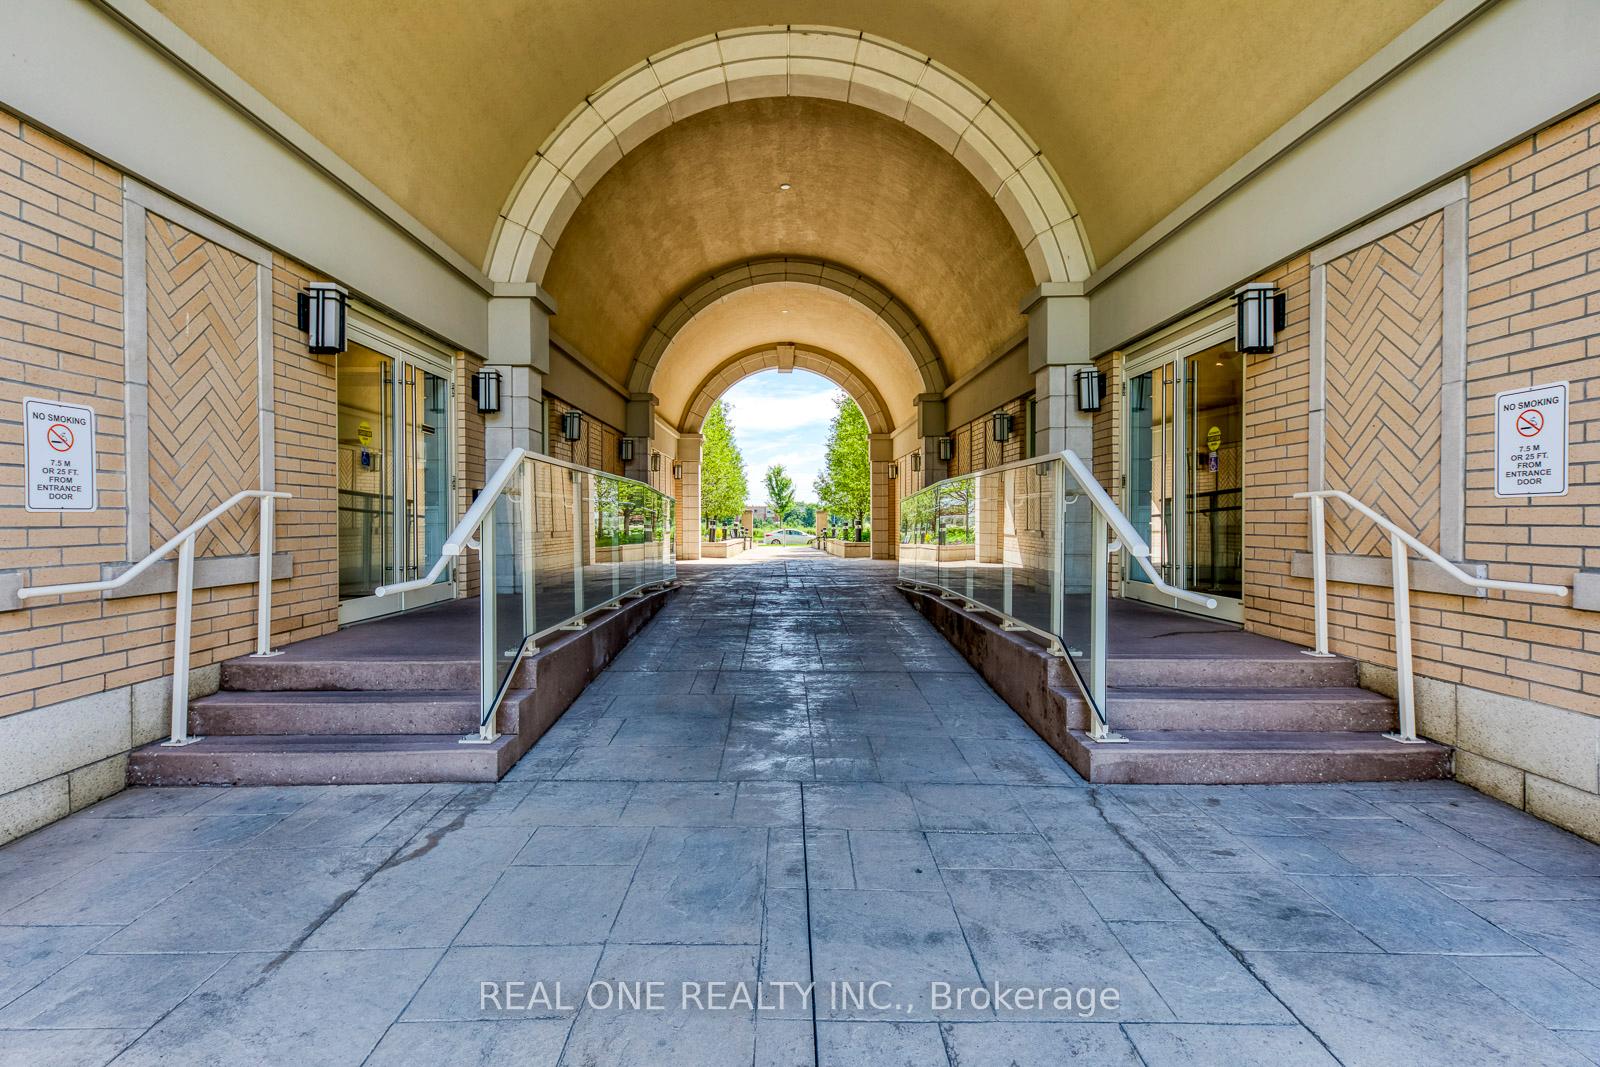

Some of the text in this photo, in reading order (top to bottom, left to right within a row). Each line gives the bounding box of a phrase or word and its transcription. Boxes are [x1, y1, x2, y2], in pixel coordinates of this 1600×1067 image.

[1504, 396, 1559, 412] NO SMOKING
[32, 412, 86, 425] NO SMOKING
[1506, 469, 1551, 478] ENTRANCE
[37, 484, 82, 492] ENTRANCE
